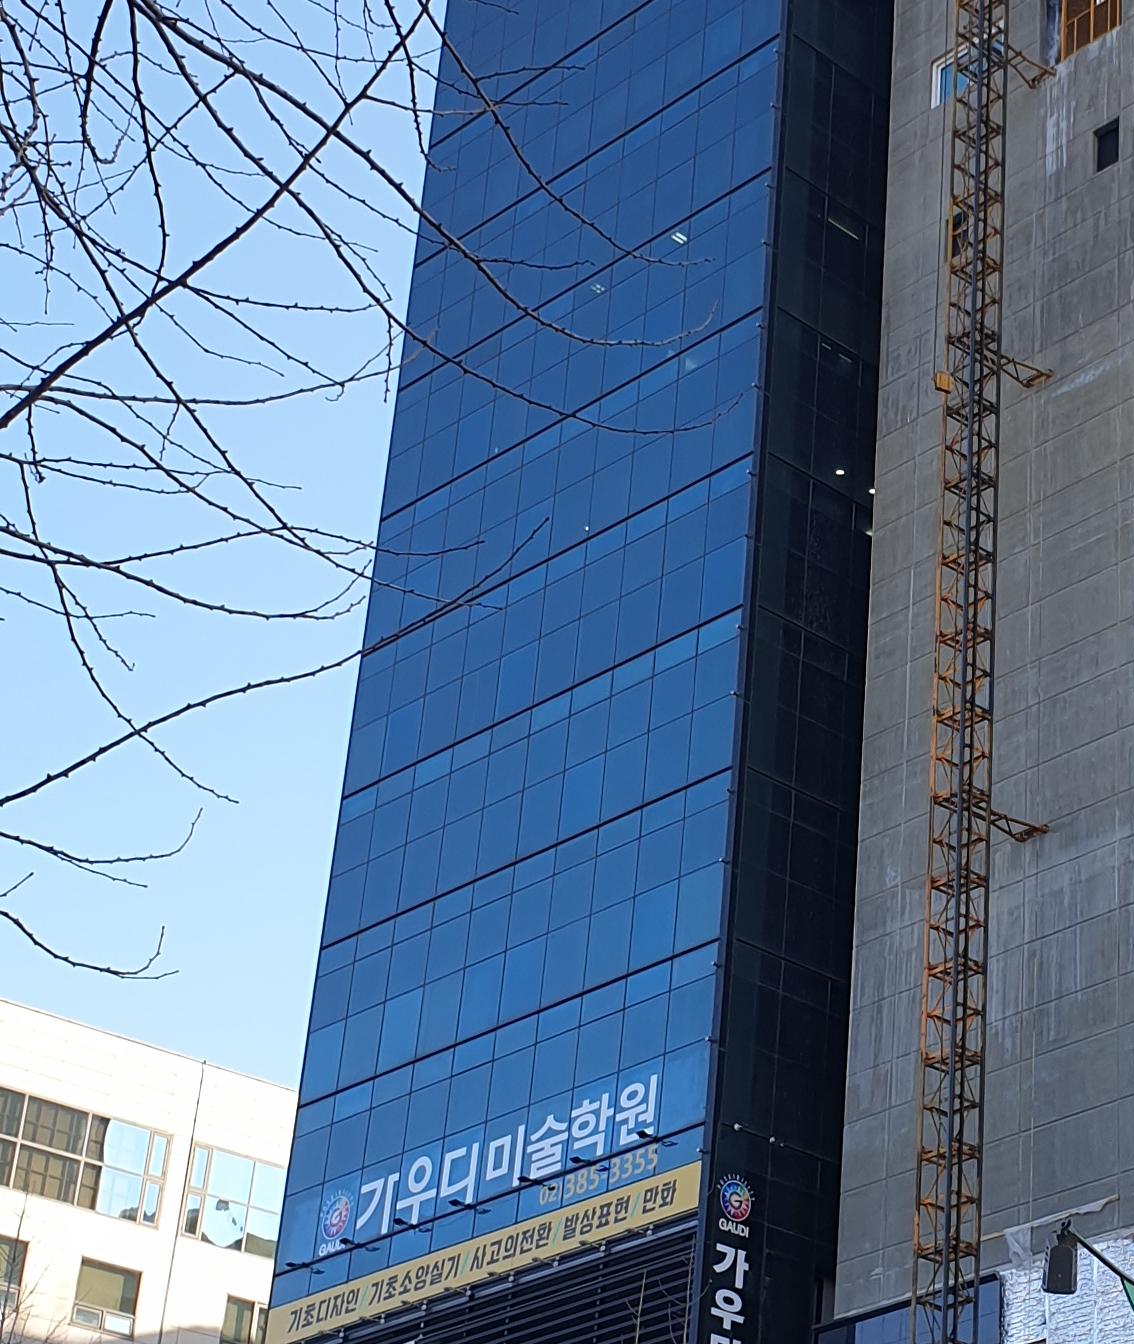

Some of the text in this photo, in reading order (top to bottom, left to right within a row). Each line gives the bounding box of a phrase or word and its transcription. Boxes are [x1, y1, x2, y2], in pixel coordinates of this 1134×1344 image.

[355, 1074, 658, 1235] 가우디미술학원
[718, 1217, 750, 1238] GAUDI
[287, 1289, 360, 1333] 기초디자인
[368, 1255, 461, 1305] 기초소양실기
[469, 1221, 552, 1273] 사고의전환
[562, 1194, 631, 1241] 발상표현
[642, 1178, 678, 1214] 만화
